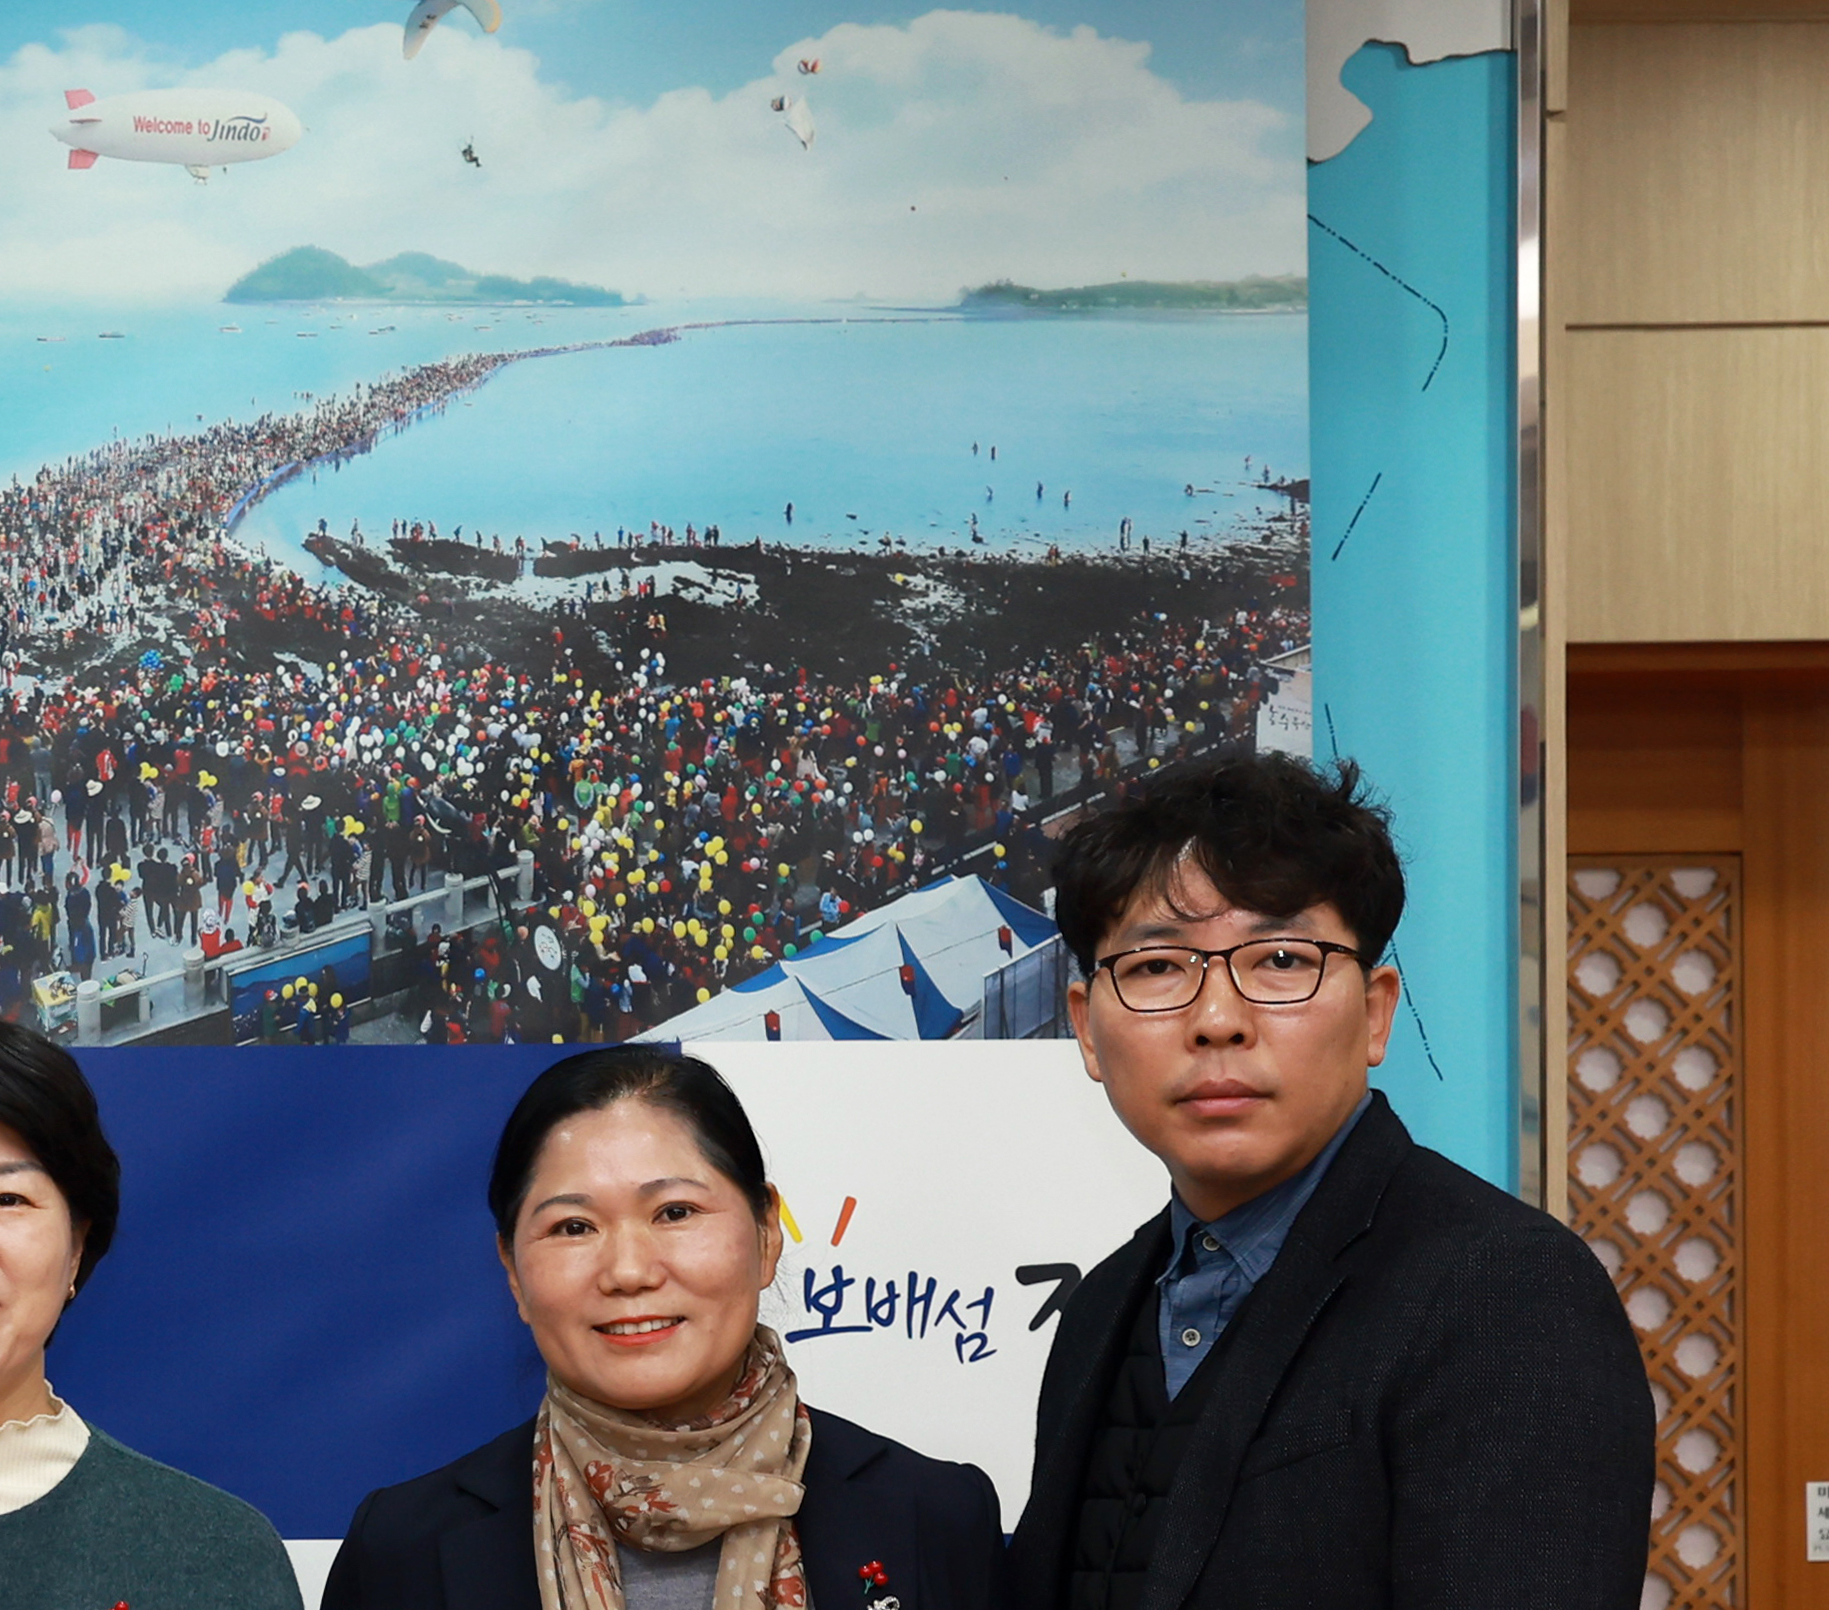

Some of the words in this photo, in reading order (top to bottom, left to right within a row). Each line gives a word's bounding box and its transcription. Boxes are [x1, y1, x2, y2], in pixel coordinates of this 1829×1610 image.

[133, 115, 193, 134] Welcome
[198, 119, 210, 135] to
[206, 118, 261, 142] Jindo
[785, 1265, 997, 1364] 보배섬
